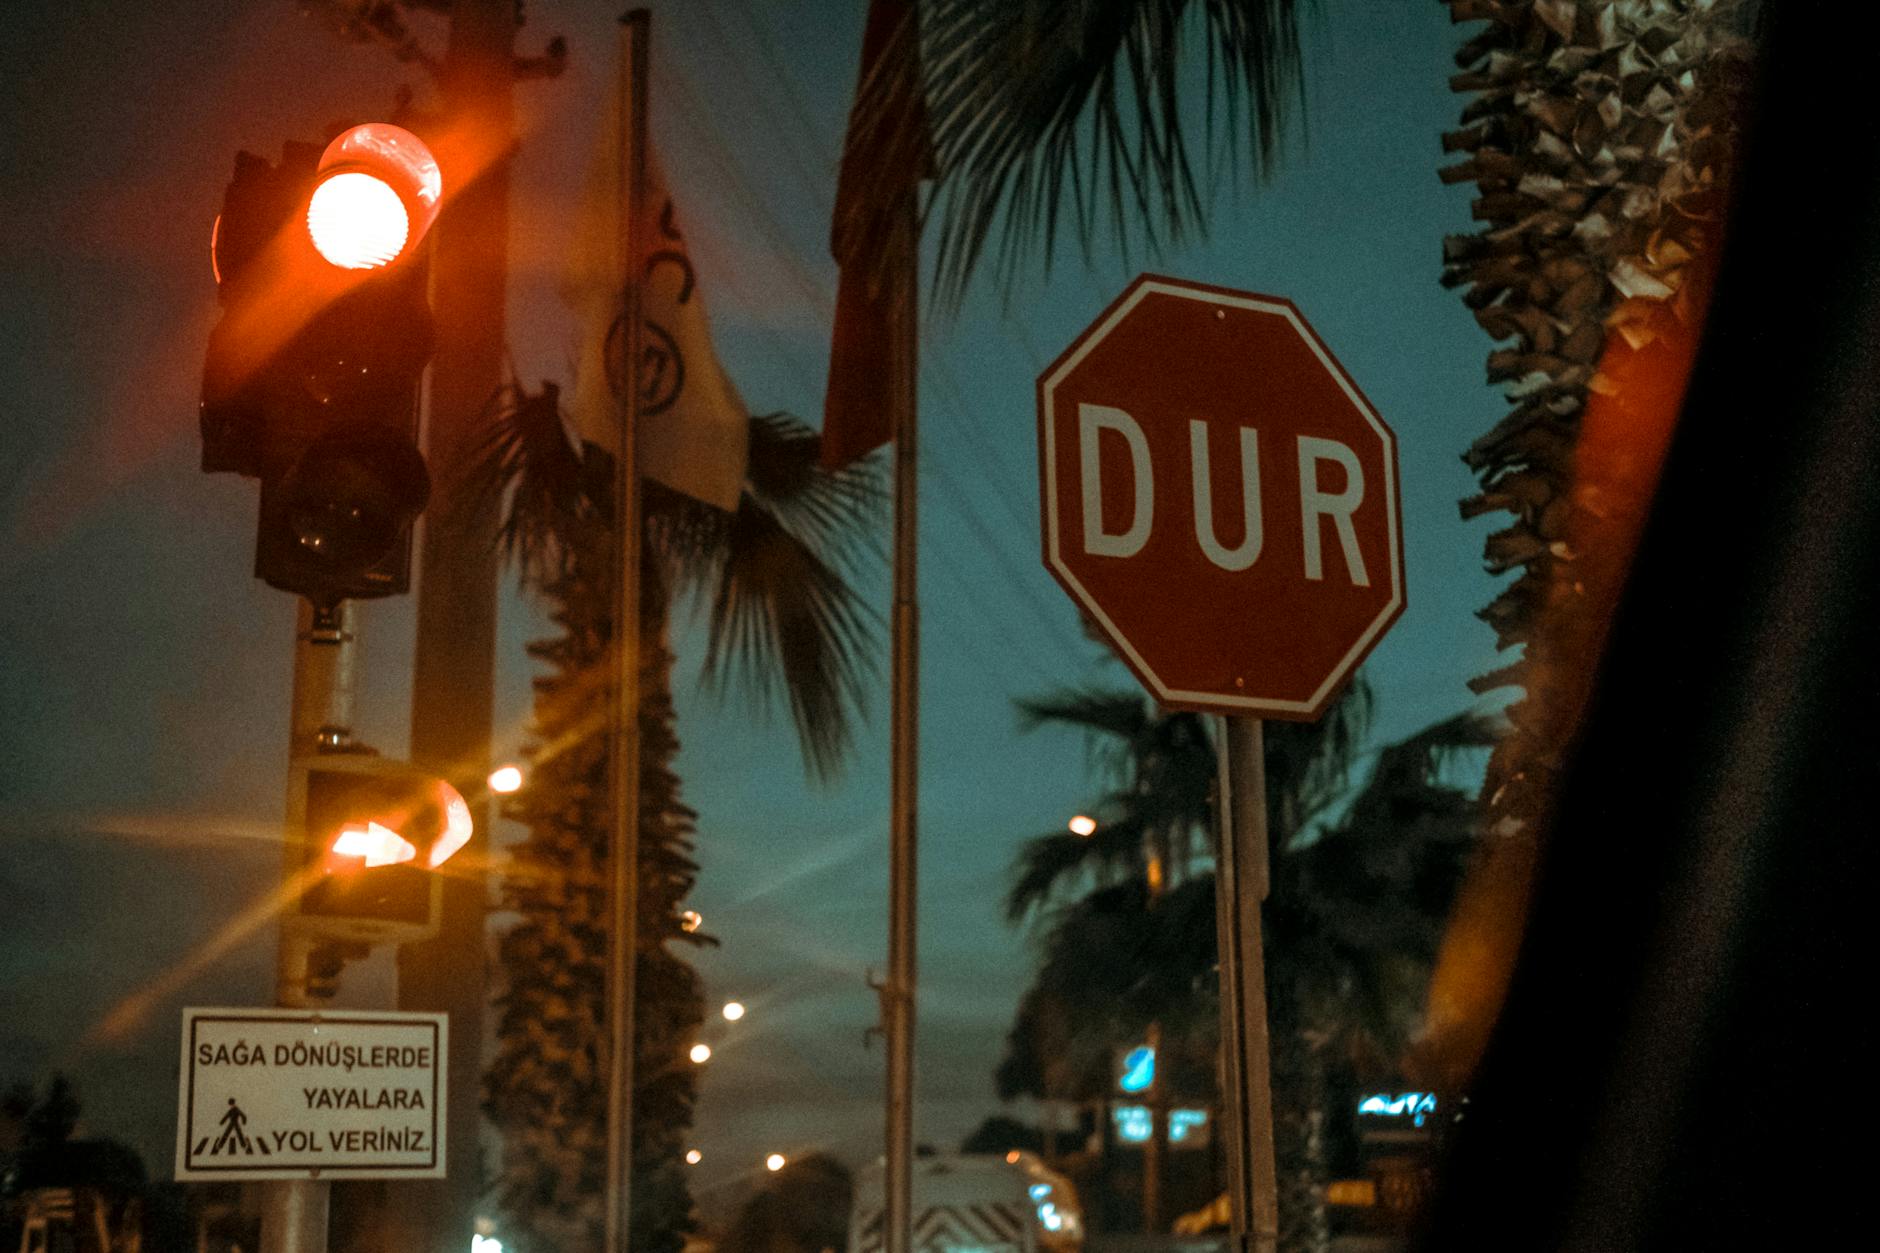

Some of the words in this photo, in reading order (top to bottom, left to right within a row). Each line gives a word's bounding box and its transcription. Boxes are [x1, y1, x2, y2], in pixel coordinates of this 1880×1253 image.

[1079, 402, 1370, 588] DUR
[198, 1039, 266, 1067] SAĞA
[274, 1041, 430, 1073] DÖNÜŞLERDE
[303, 1088, 425, 1110] YAYALARA
[273, 1131, 322, 1152] YOL
[329, 1126, 431, 1152] VERİNİZ.
